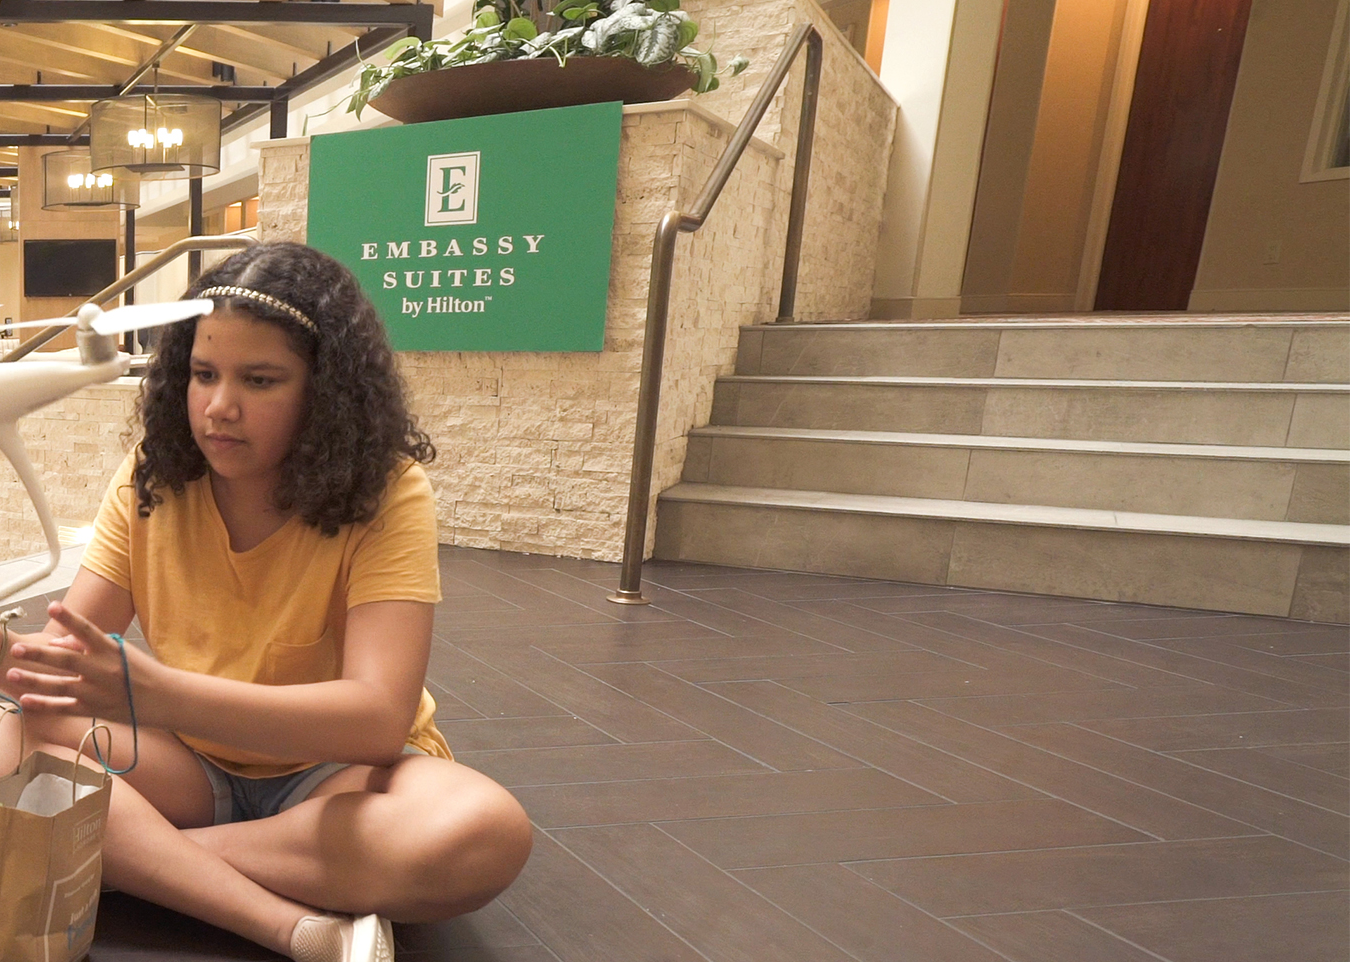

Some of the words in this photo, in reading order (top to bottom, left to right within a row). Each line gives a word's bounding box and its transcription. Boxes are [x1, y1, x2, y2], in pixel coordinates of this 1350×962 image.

[360, 234, 545, 261] EMBASSY
[382, 267, 516, 289] SUITES
[401, 297, 424, 318] by
